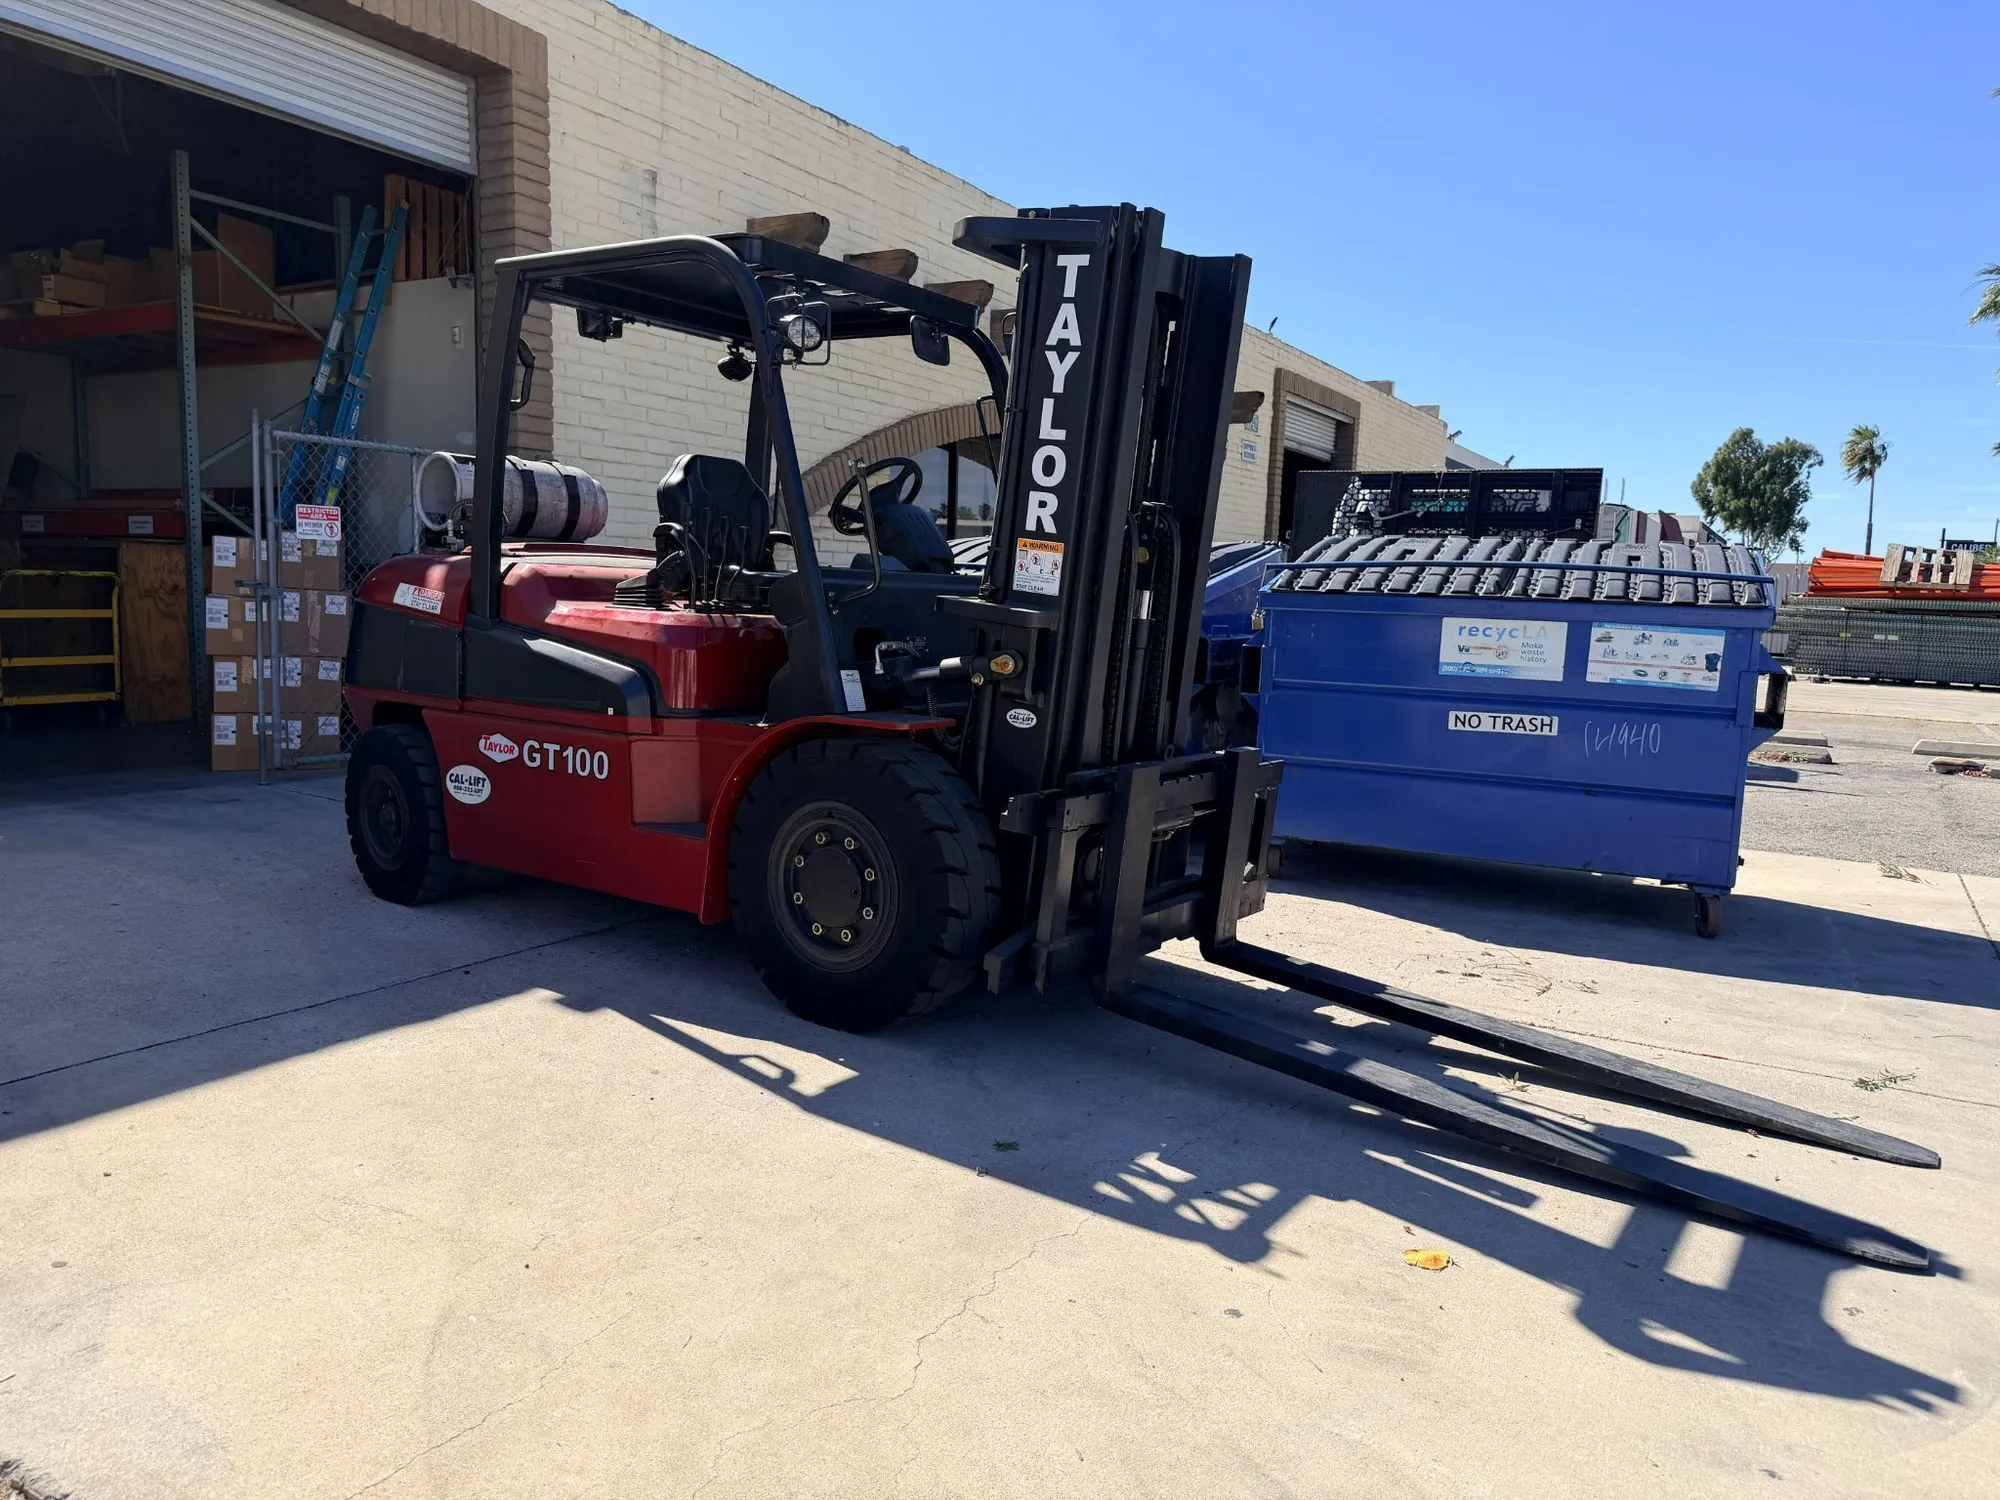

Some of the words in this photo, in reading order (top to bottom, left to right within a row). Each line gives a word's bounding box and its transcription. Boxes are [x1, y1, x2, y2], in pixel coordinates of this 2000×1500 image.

[1025, 254, 1091, 534] TAYLOR
[298, 507, 338, 515] RESTRICTED
[1029, 541, 1059, 552] WARNING
[1458, 624, 1548, 641] recycLA
[1521, 642, 1544, 650] Make
[1520, 655, 1548, 664] history
[1009, 713, 1035, 724] CAL-LIFT
[1454, 714, 1482, 730] NO
[1488, 715, 1554, 733] TRASH
[481, 735, 516, 756] TAYLOR
[522, 739, 610, 780] GT100
[448, 772, 487, 788] CAL-LIFT
